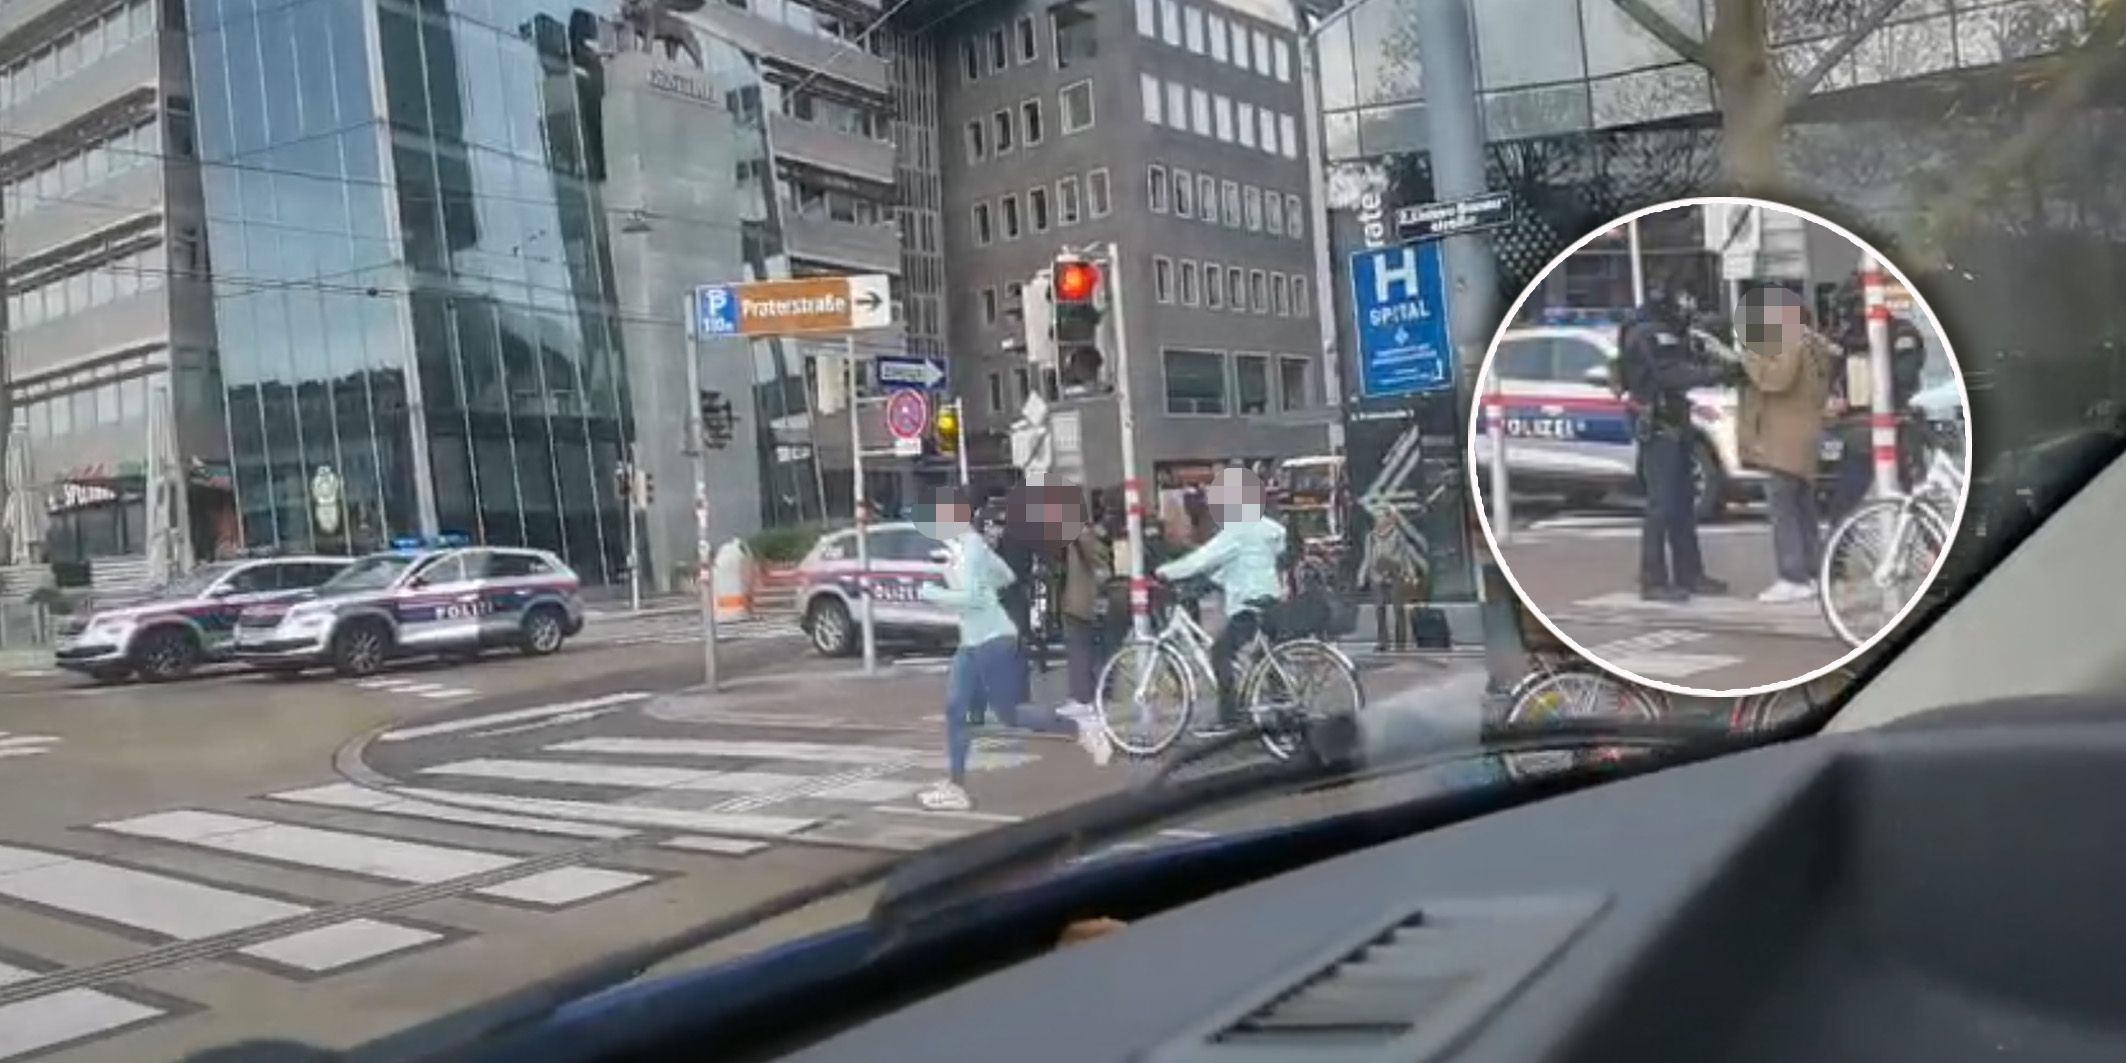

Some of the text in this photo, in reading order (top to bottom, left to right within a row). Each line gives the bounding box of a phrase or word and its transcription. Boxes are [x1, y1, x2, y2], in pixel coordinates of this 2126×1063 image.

[1372, 248, 1419, 304] H
[709, 294, 728, 317] P
[741, 292, 845, 319] Praterstraße
[1369, 299, 1432, 327] SPITAL
[1501, 418, 1575, 439] OLIZEI
